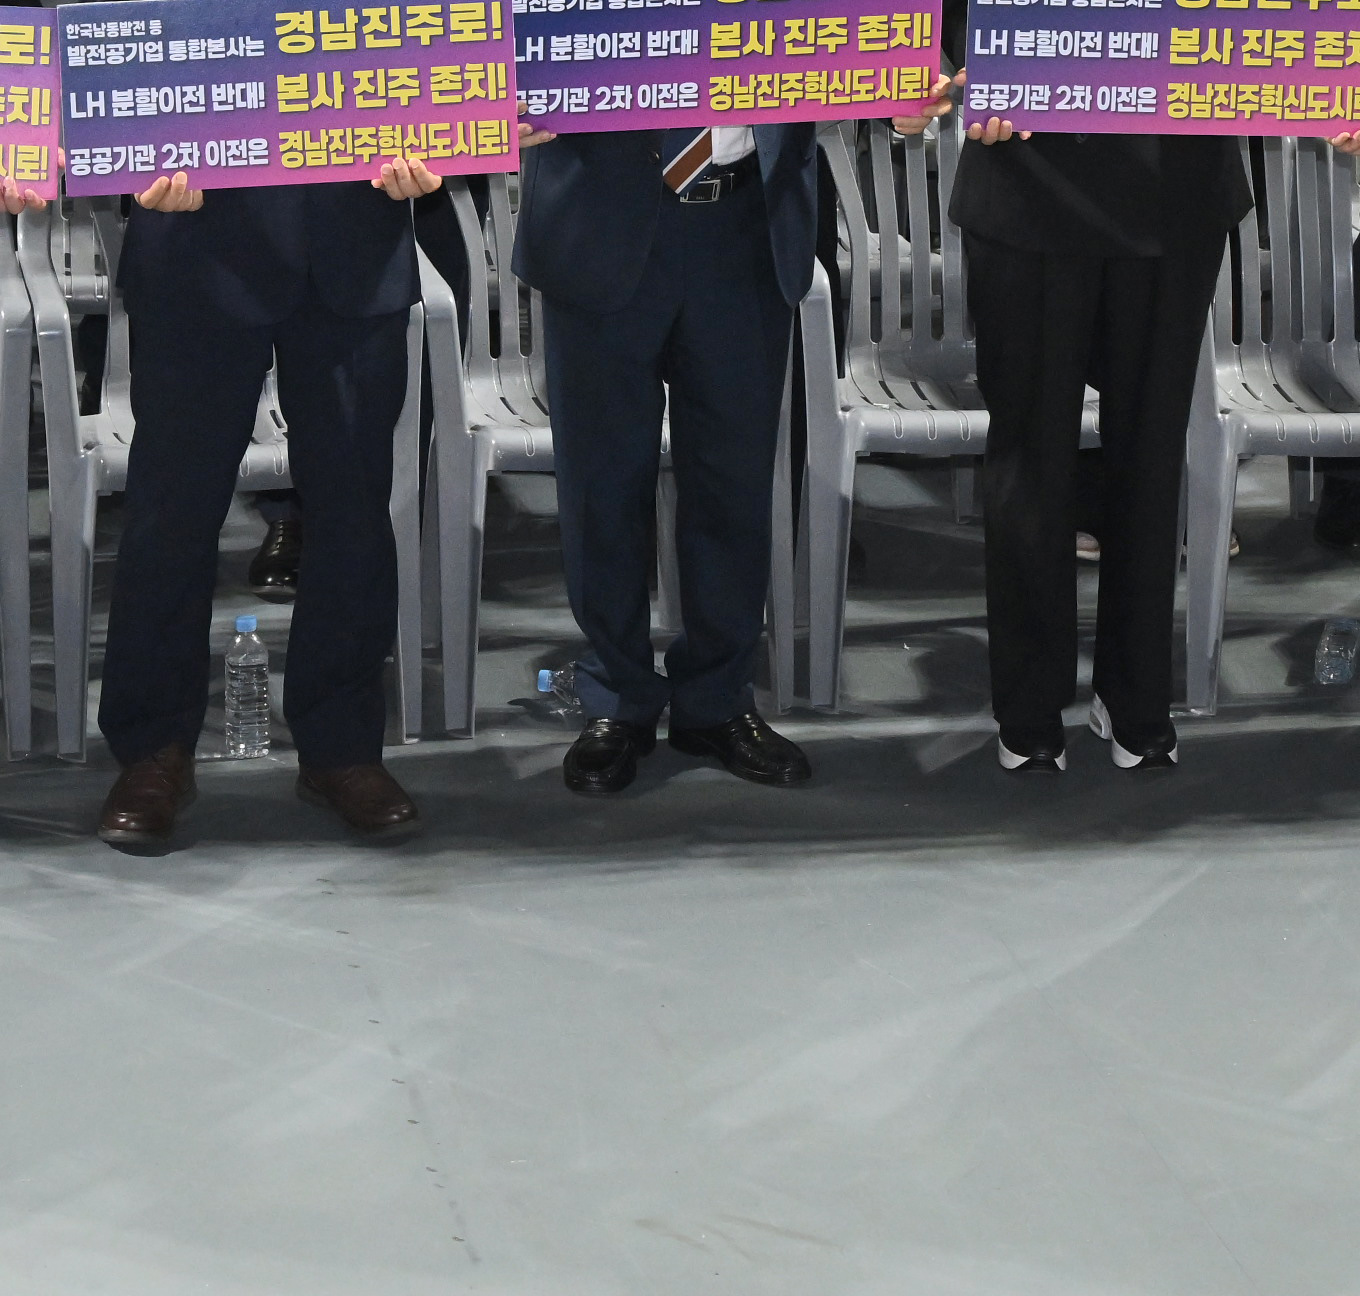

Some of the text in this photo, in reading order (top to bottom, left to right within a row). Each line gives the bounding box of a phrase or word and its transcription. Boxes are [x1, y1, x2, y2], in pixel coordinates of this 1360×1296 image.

[66, 20, 162, 37] 한국남동발전 등
[67, 1, 502, 66] 발전공기업 통합본사는 경남진주로!
[550, 13, 931, 61] 분할이전 반대! 본사 진주 존치!
[974, 29, 1007, 55] LH
[1014, 29, 1102, 58] 분할이전
[1108, 32, 1158, 59] 반대!
[1169, 27, 1234, 65] 본사
[1242, 29, 1304, 67] 진주
[69, 63, 507, 118] LH 분할이전 반대! 본사 진주 존치!
[595, 66, 929, 112] 2차 이전은 경남진주혁신도시로!
[969, 83, 1050, 111] 공공기관
[1056, 85, 1092, 110] 2차
[1097, 86, 1157, 113] 이전은
[70, 119, 509, 175] 공공기관 2차 이전은 경남진주혁신도시로!
